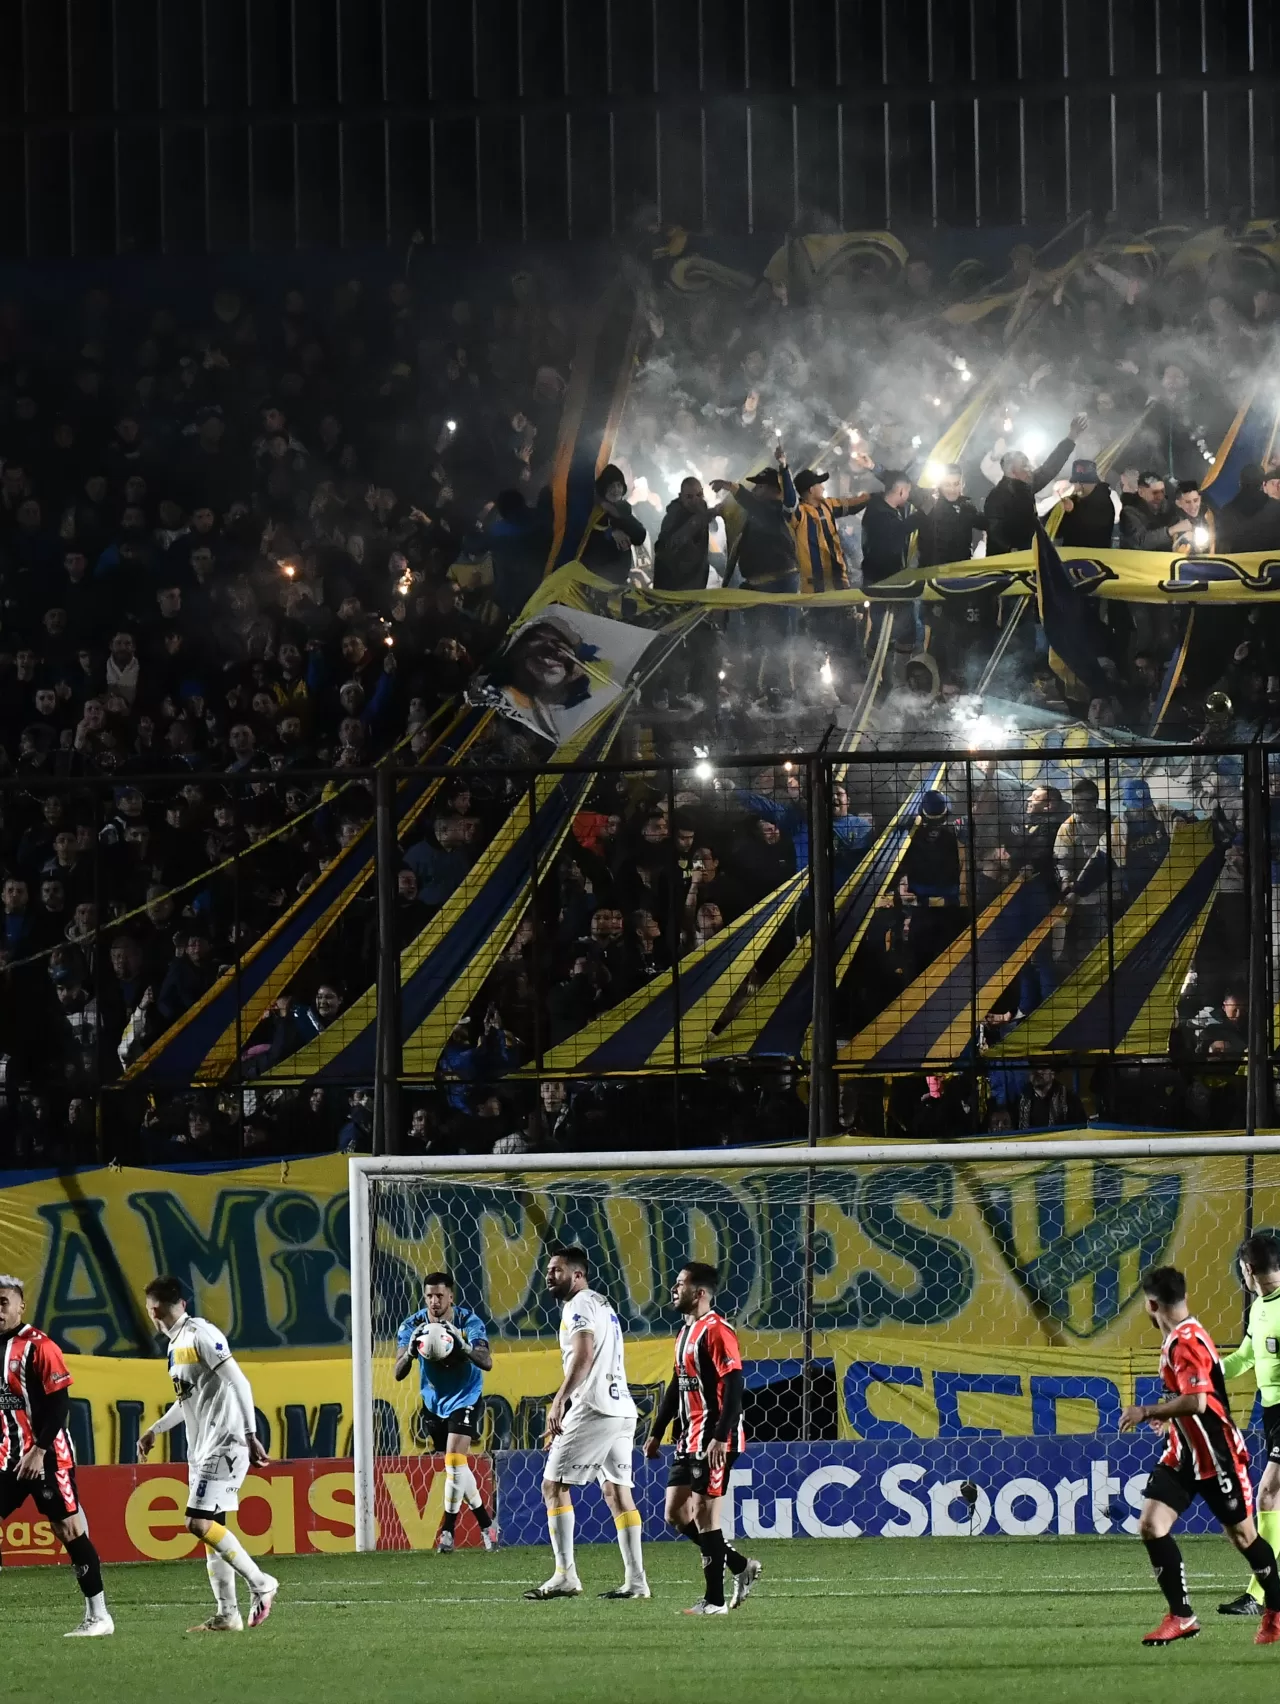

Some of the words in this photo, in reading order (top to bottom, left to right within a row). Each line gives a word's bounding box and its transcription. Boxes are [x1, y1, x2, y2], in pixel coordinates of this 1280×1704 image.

[728, 1466, 863, 1539] TuC
[880, 1460, 1145, 1538] Sports
[1217, 1471, 1235, 1495] 5
